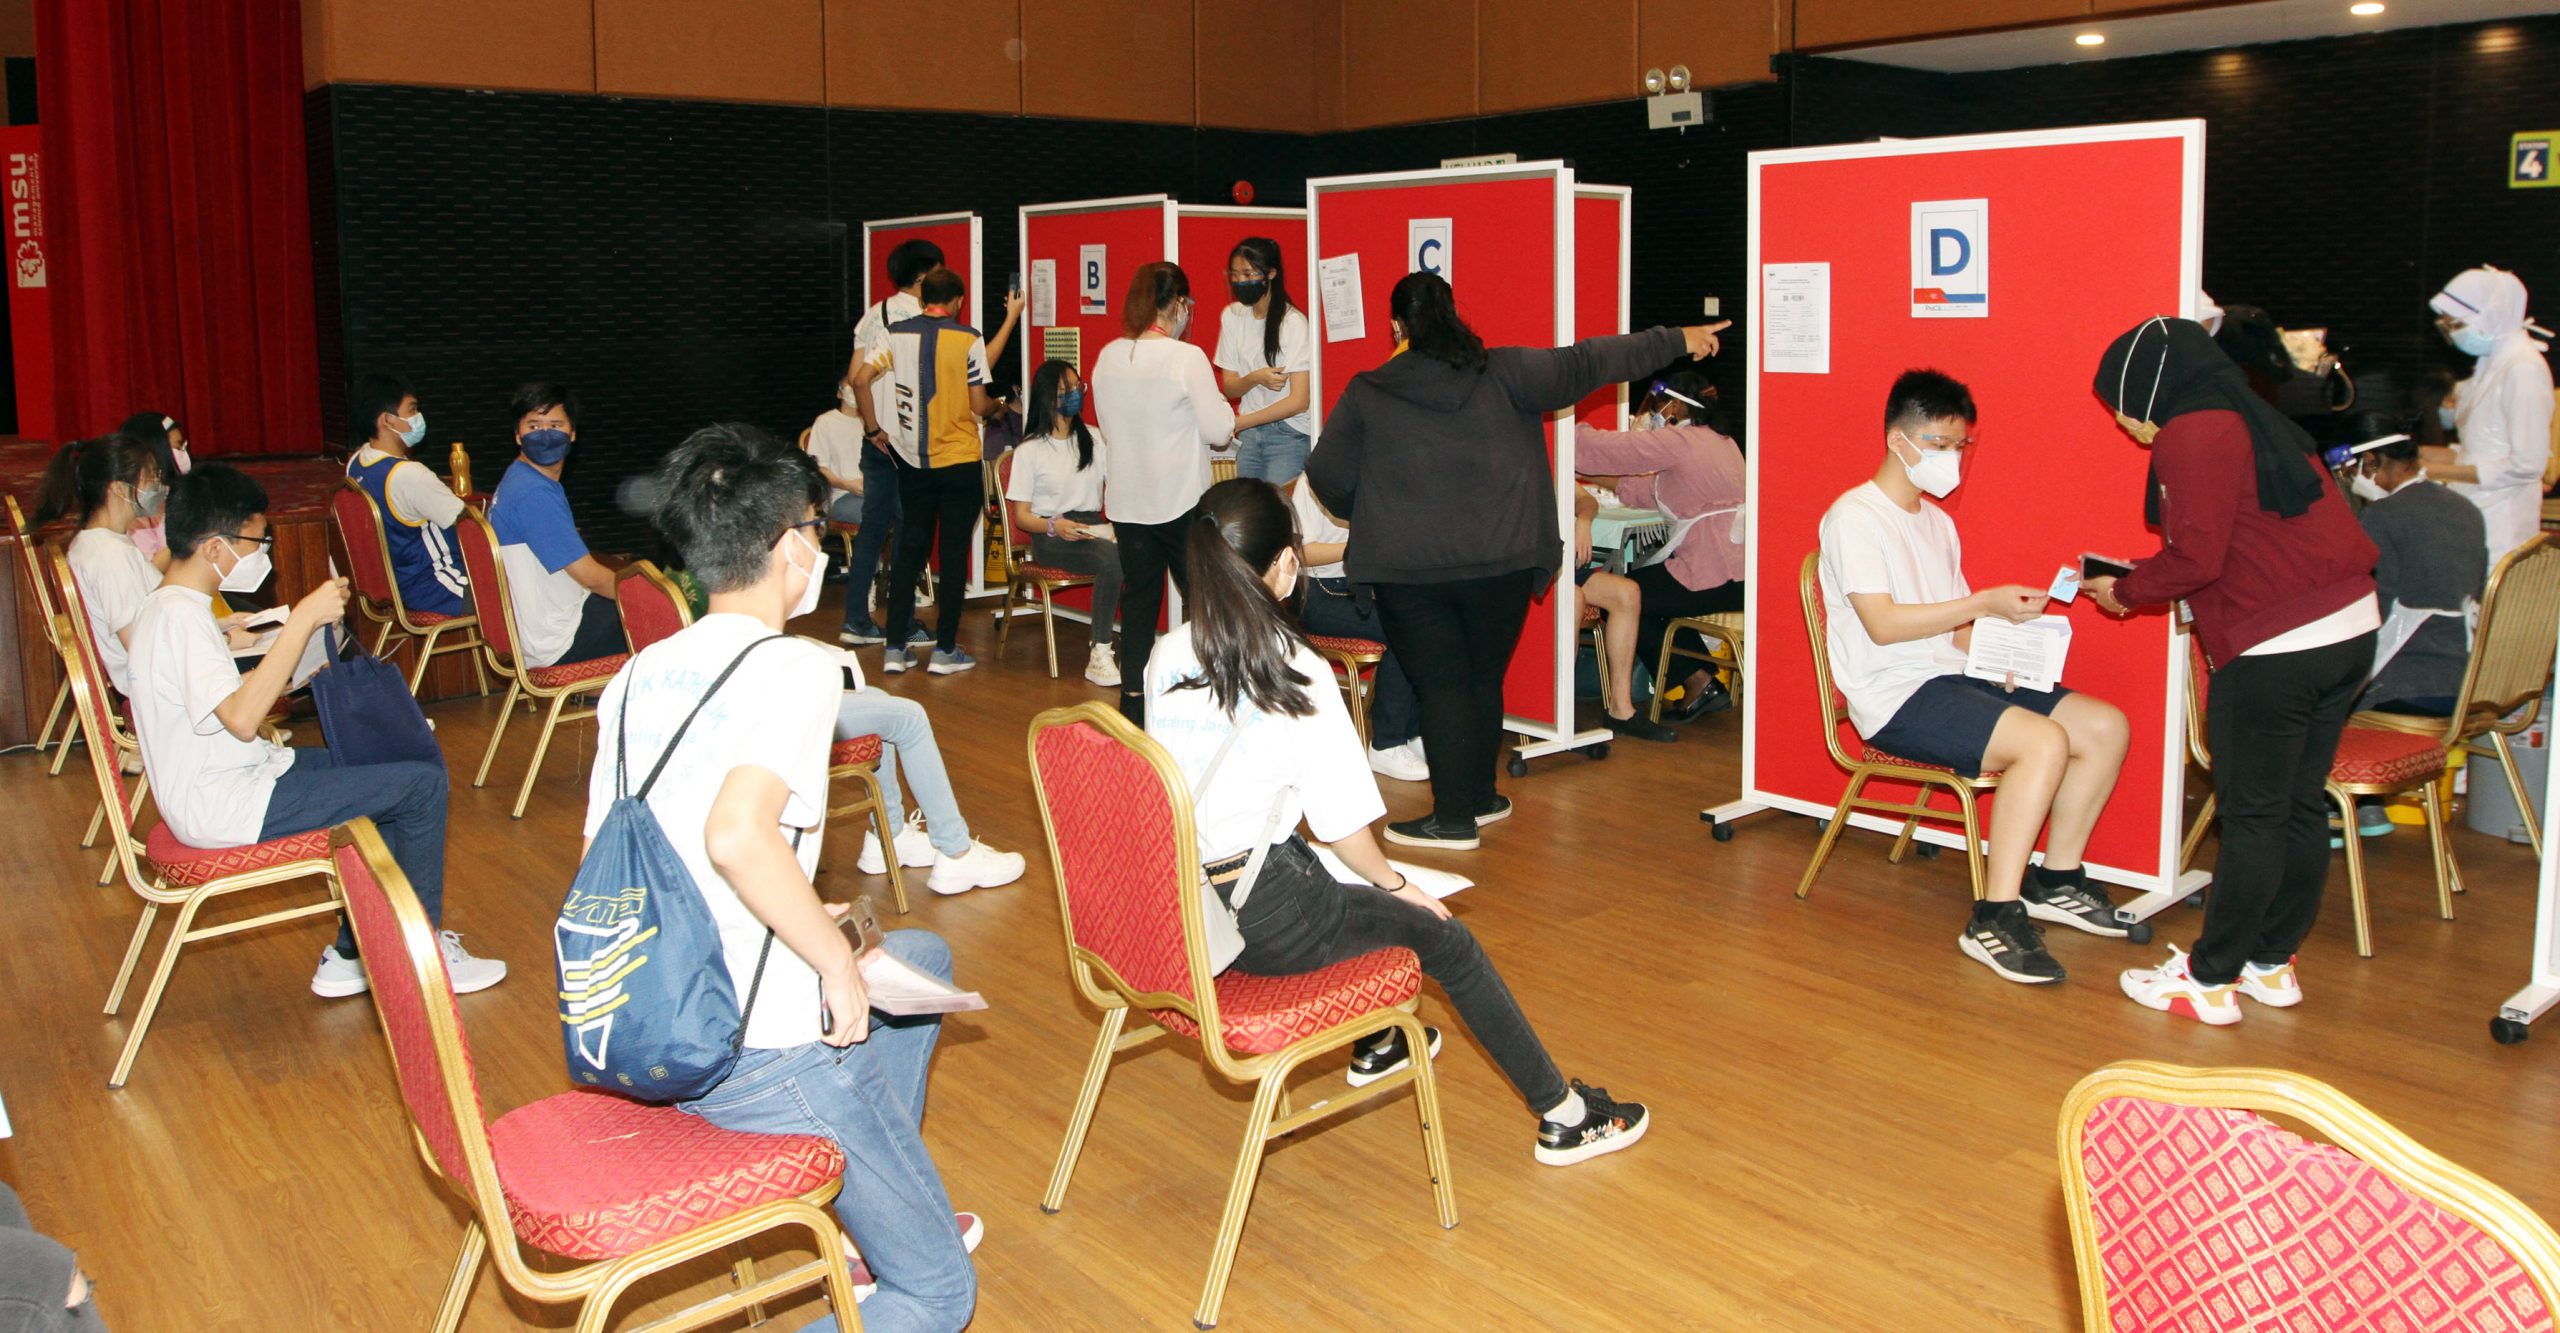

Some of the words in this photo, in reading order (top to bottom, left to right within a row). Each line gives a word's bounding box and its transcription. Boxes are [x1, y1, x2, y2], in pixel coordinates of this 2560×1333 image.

[2519, 150, 2544, 178] 4
[10, 153, 31, 237] msu
[1419, 239, 1442, 274] C
[1930, 228, 1971, 276] D
[1087, 261, 1100, 289] B
[895, 382, 914, 431] MSU
